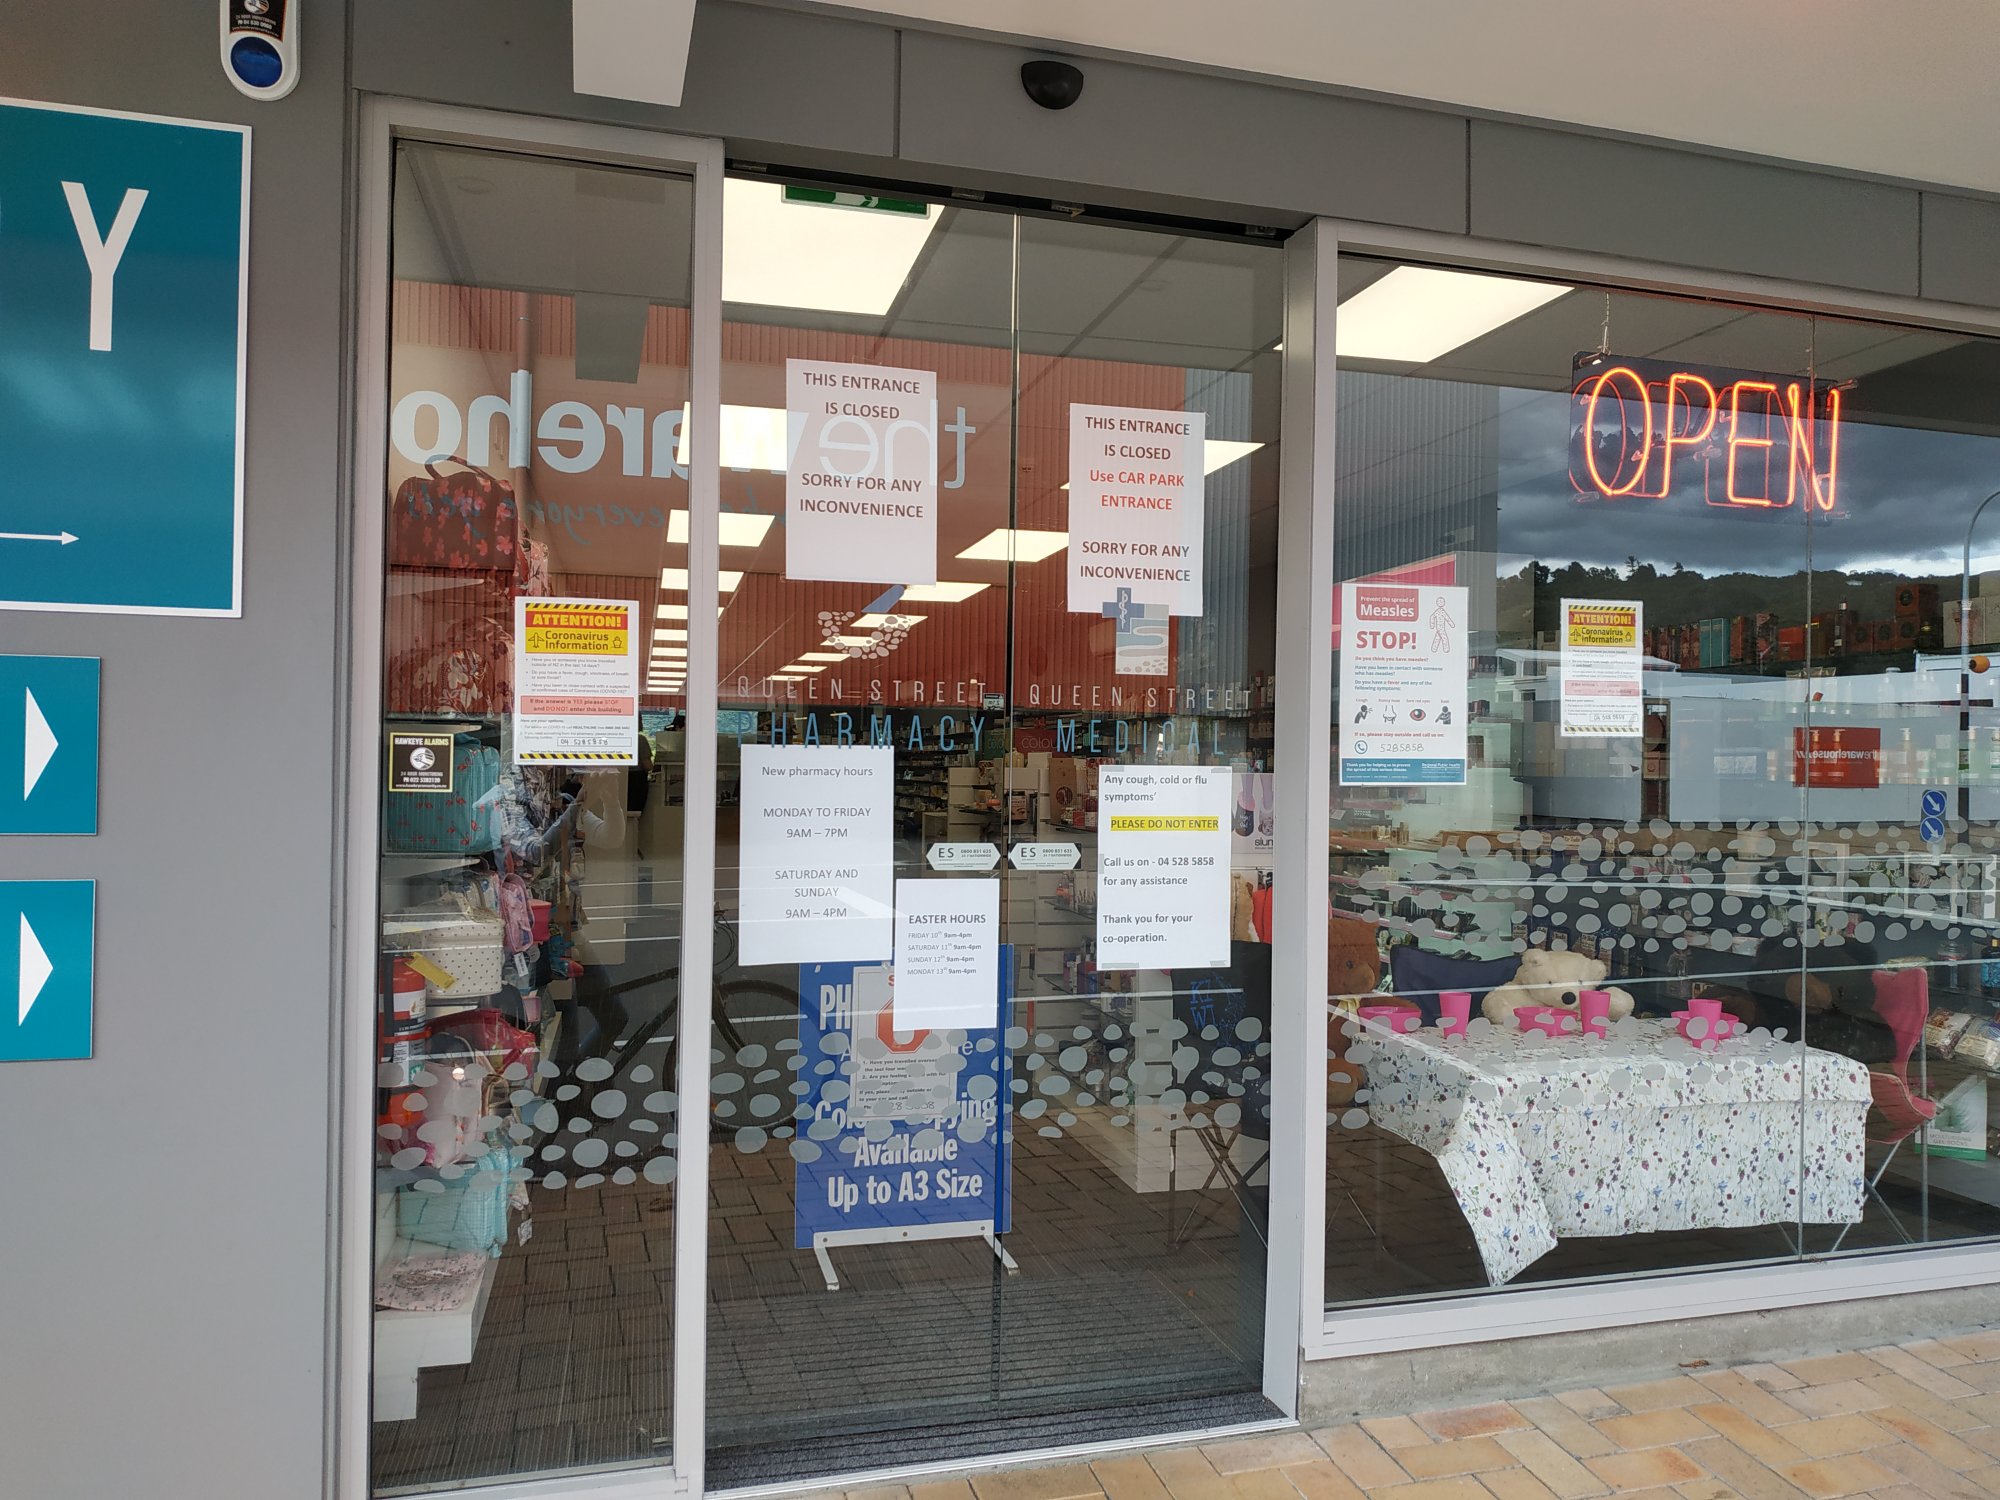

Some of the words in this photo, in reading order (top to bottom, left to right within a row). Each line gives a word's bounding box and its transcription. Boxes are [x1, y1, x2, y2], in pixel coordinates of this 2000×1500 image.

[61, 180, 149, 351] Y
[803, 372, 837, 387] THIS
[842, 375, 920, 394] ENTRANCE
[825, 402, 838, 414] IS
[843, 403, 900, 419] CLOSED
[1085, 417, 1115, 430] THIS
[1120, 420, 1190, 435] ENTRANCE
[1585, 366, 1841, 511] OPEN
[1104, 445, 1115, 456] IS
[1120, 445, 1170, 460] CLOSED
[802, 473, 852, 488] SORRY
[857, 477, 886, 490] FOR
[891, 479, 922, 492] ANY
[1090, 470, 1114, 482] Use
[1118, 472, 1145, 484] CAR
[1150, 473, 1184, 487] PARK
[800, 499, 924, 518] INCONVENIENCE
[1101, 495, 1172, 510] ENTRANCE
[1082, 541, 1127, 555] SORRY
[1131, 543, 1157, 556] FOR
[1162, 545, 1190, 558] ANY
[1080, 565, 1191, 581] INCONVENIENCE
[1360, 604, 1414, 617] Measles
[533, 614, 621, 627] ATTENTION!
[1574, 614, 1631, 624] ATTENTION!
[546, 631, 608, 640] Coronavirus
[1356, 631, 1416, 650] STOP!
[1582, 635, 1623, 643] Information
[546, 641, 608, 650] Information
[737, 676, 842, 700] QUEEN
[870, 679, 986, 704] STREET
[1029, 683, 1122, 707] QUEEN
[1147, 687, 1251, 711] STREET
[737, 711, 985, 752] PHARMACY
[1057, 718, 1224, 755] MEDICAL
[1380, 743, 1424, 752] 5285858
[762, 766, 786, 776] New
[789, 766, 841, 778] pharmacy
[844, 766, 873, 776] hours
[1105, 775, 1123, 785] Any
[1126, 774, 1157, 785] cough,
[1160, 774, 1179, 784] cold
[1194, 774, 1207, 784] flu
[763, 807, 813, 818] MONDAY
[816, 807, 831, 817] TO
[834, 807, 871, 817] FRIDAY
[1111, 820, 1144, 828] PLEASE
[1148, 820, 1162, 828] DO
[1166, 820, 1186, 828] NOT
[1189, 820, 1218, 828] ENTER
[787, 828, 811, 838] 9AM
[824, 828, 848, 838] 7PM
[1104, 857, 1121, 867] Call
[1158, 858, 1169, 866] 04
[1172, 857, 1189, 866] 528
[1192, 857, 1214, 866] 5858
[775, 869, 832, 880] SATURDAY
[835, 869, 858, 878] AND
[1104, 876, 1118, 886] for
[1120, 878, 1137, 888] any
[1140, 876, 1188, 886] assistance
[794, 888, 839, 898] SUNDAY
[785, 908, 810, 919] 9AM
[823, 908, 847, 918] 4PM
[909, 915, 947, 924] EASTER
[950, 915, 986, 923] HOURS
[1103, 914, 1132, 924] Thank
[1135, 916, 1152, 925] you
[1155, 913, 1169, 923] for
[1171, 915, 1192, 925] your
[1103, 932, 1167, 944] co-operation.
[828, 1176, 859, 1212] Up
[866, 1176, 891, 1204] to
[898, 1170, 928, 1202] A3
[936, 1168, 983, 1199] Size
